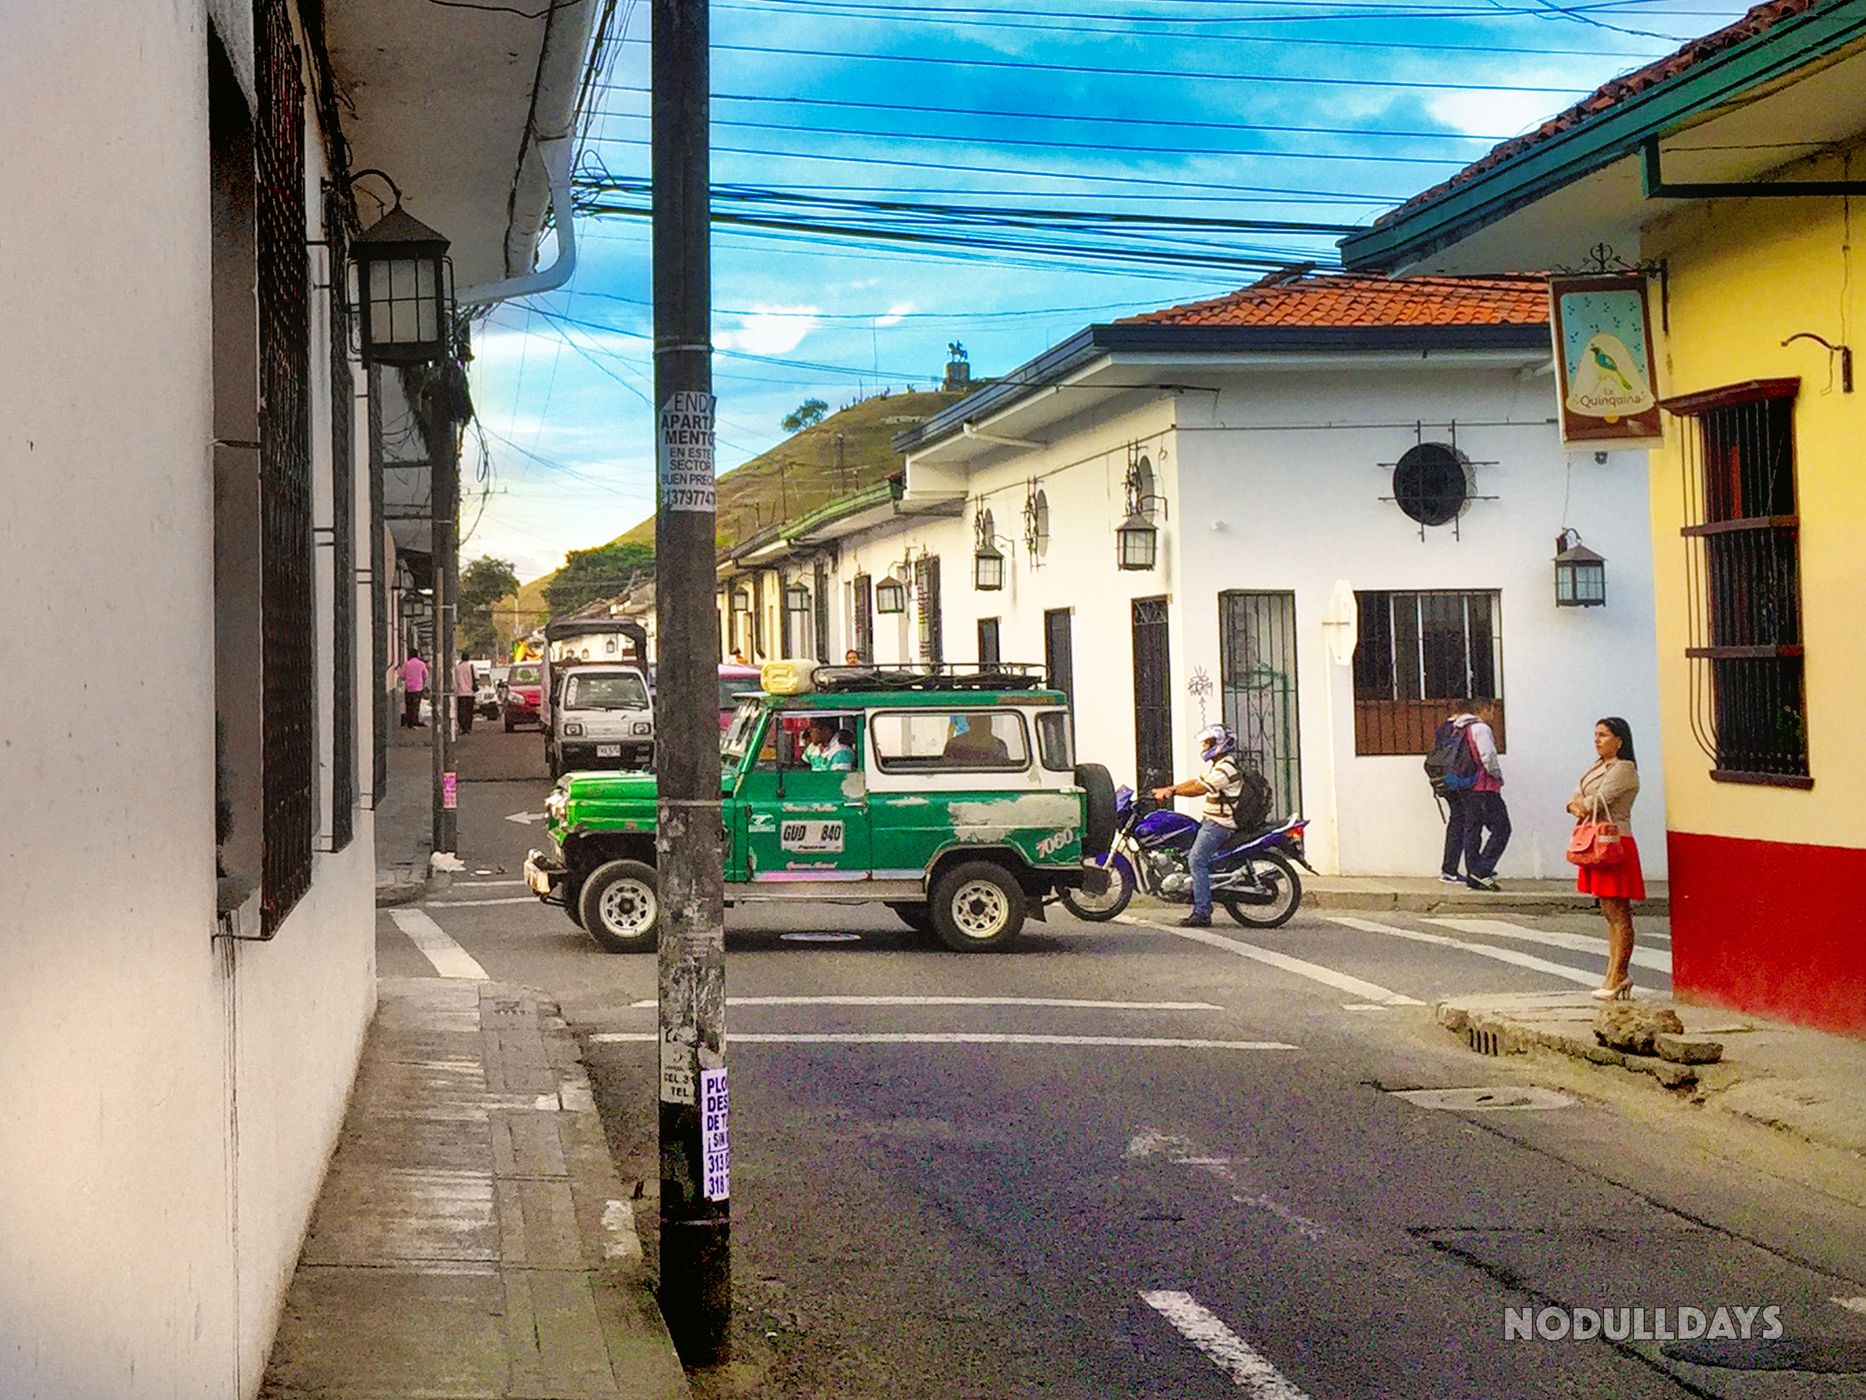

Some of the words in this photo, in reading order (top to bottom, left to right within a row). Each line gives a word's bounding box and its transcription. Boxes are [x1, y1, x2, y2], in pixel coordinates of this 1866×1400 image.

[669, 448, 685, 459] EN
[688, 448, 711, 460] ESTE
[669, 459, 712, 472] SECTOR
[783, 824, 807, 842] GUD
[820, 824, 842, 842] 840
[707, 1115, 719, 1132] DE
